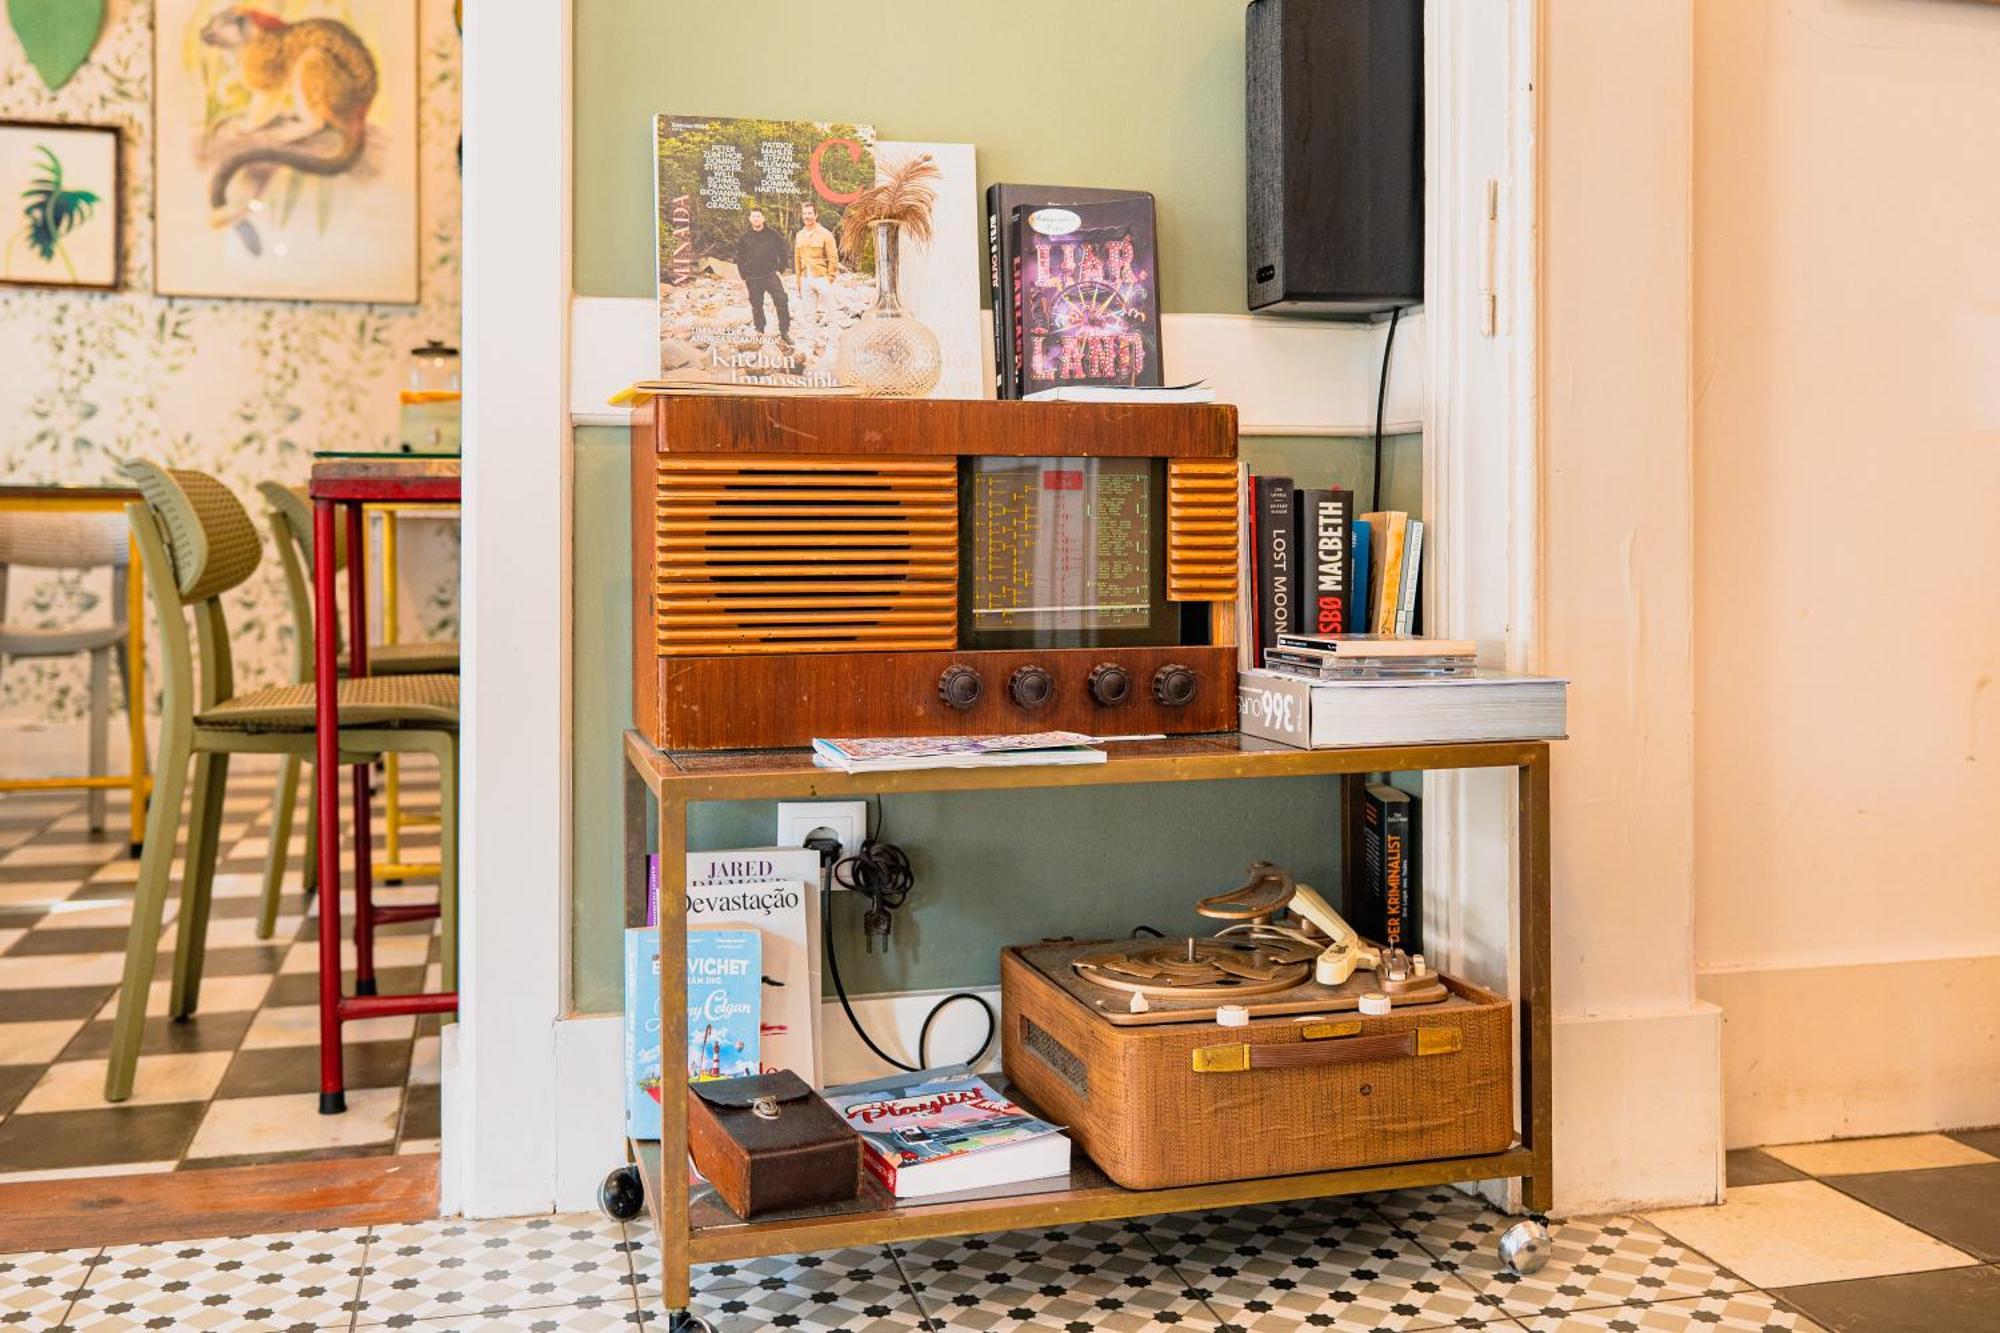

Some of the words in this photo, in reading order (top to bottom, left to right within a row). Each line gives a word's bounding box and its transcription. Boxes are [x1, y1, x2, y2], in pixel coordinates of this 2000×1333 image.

[811, 138, 865, 204] C
[1034, 235, 1139, 288] LIAR
[711, 347, 796, 369] Kitchen
[1031, 328, 1147, 381] LAND
[1273, 529, 1287, 571] LOST
[1318, 502, 1343, 590] MACBETH
[1274, 576, 1288, 633] MOON
[1319, 597, 1342, 634] SBØ
[708, 861, 773, 878] JARED
[1387, 834, 1401, 914] KRIMINALIST
